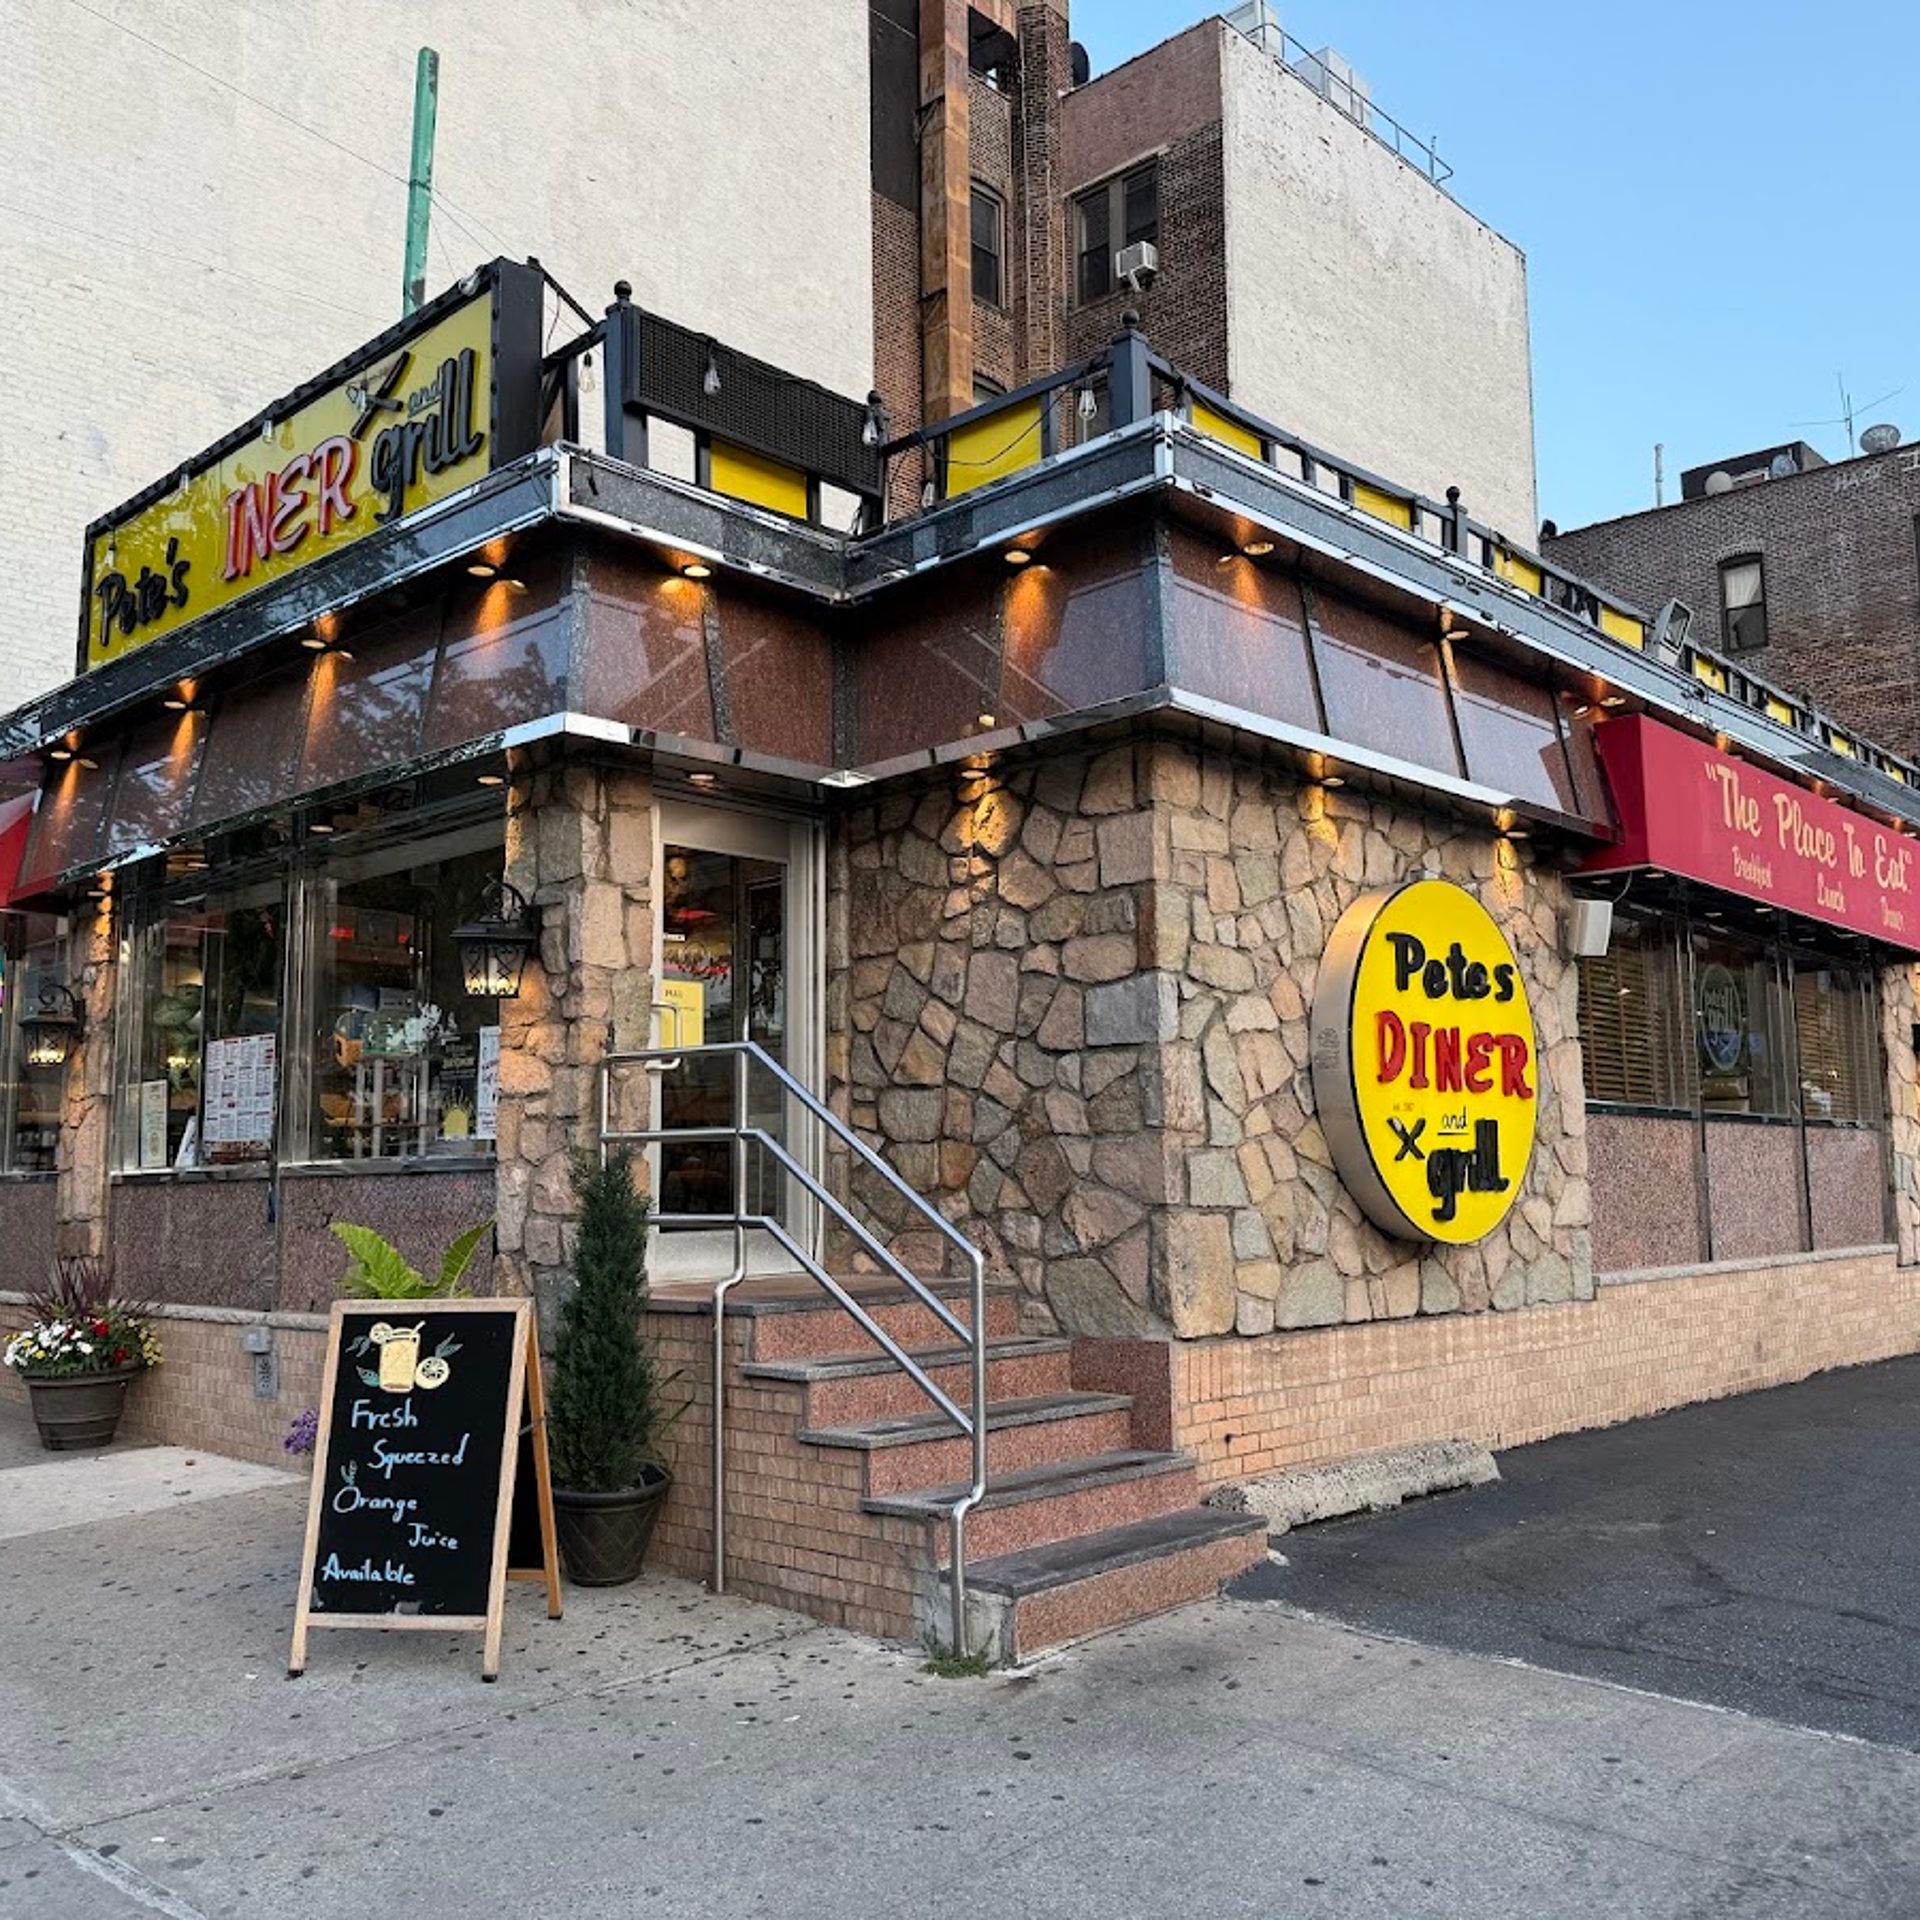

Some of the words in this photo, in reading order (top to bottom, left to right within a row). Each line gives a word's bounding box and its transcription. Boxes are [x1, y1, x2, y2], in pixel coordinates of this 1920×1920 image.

[97, 537, 190, 646] Pete's
[370, 347, 484, 525] grill
[1772, 792, 1838, 869] Place
[1842, 822, 1866, 879] To
[1386, 931, 1515, 1002] Petes
[1375, 1010, 1534, 1100] DINER
[1441, 1106, 1468, 1130] and
[1427, 1119, 1509, 1221] grill
[351, 1397, 418, 1430] Fresh
[367, 1432, 470, 1479] Squeezed
[332, 1486, 418, 1523] Orange
[407, 1522, 459, 1550] Juice
[321, 1552, 416, 1585] Available
